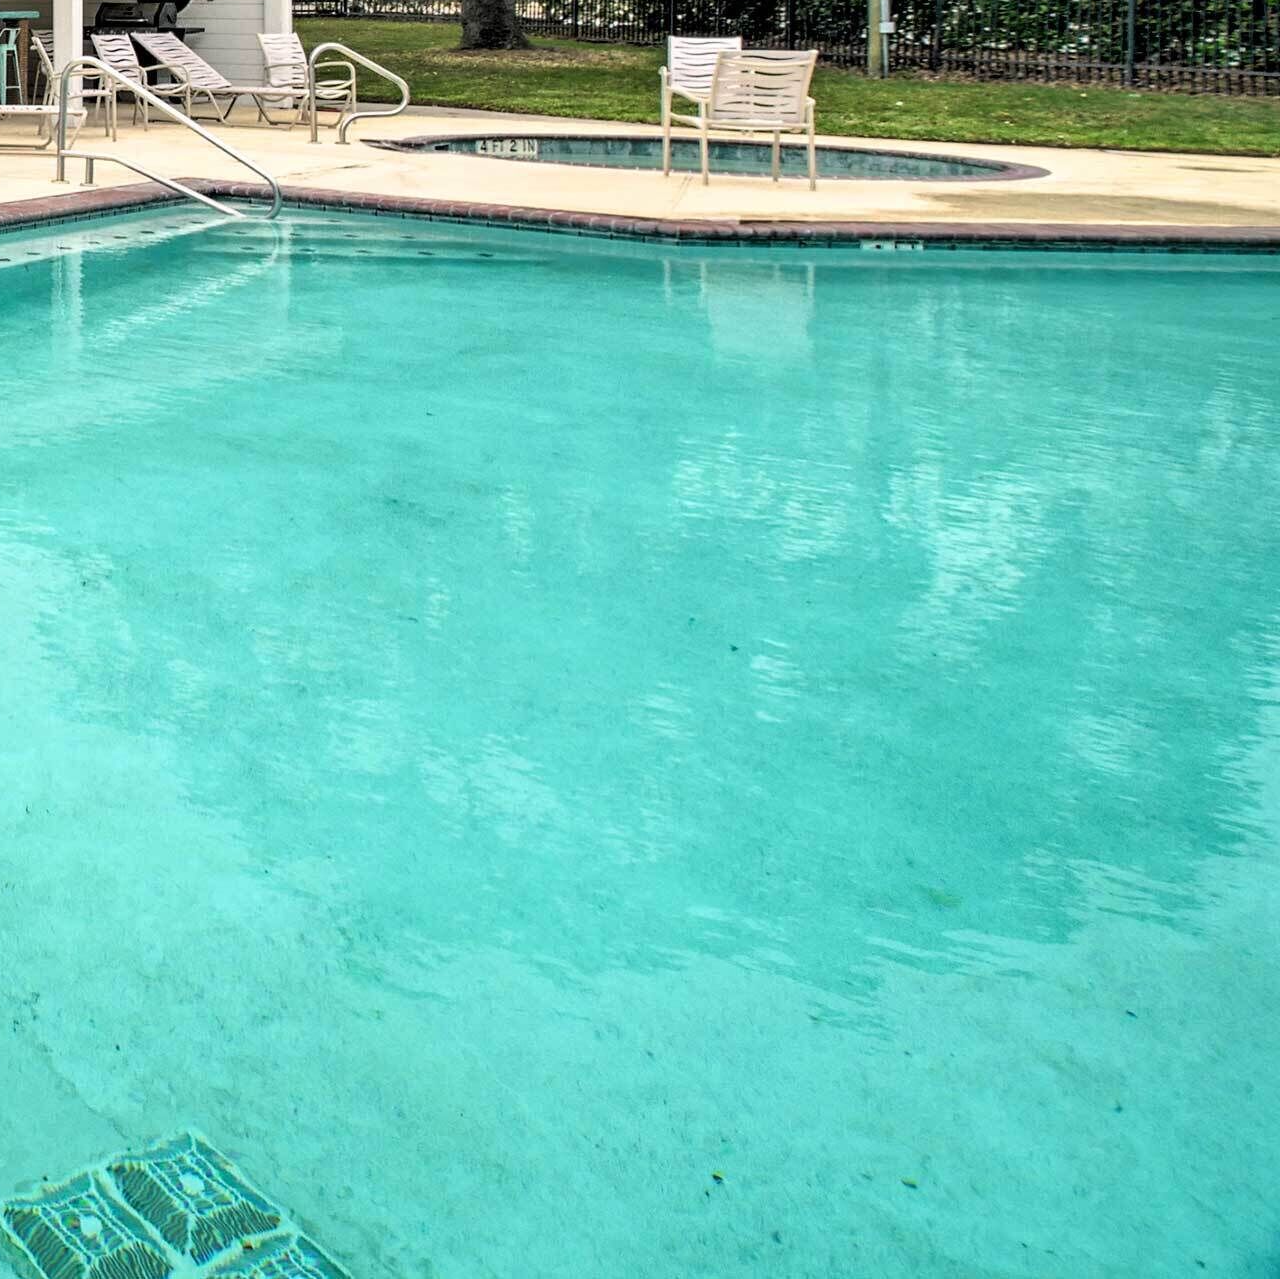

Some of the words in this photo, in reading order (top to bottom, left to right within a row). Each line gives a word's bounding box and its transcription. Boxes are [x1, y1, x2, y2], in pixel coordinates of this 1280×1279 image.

[480, 139, 487, 152] 4
[492, 138, 504, 152] FT
[509, 139, 517, 152] 2
[523, 139, 535, 152] IN
